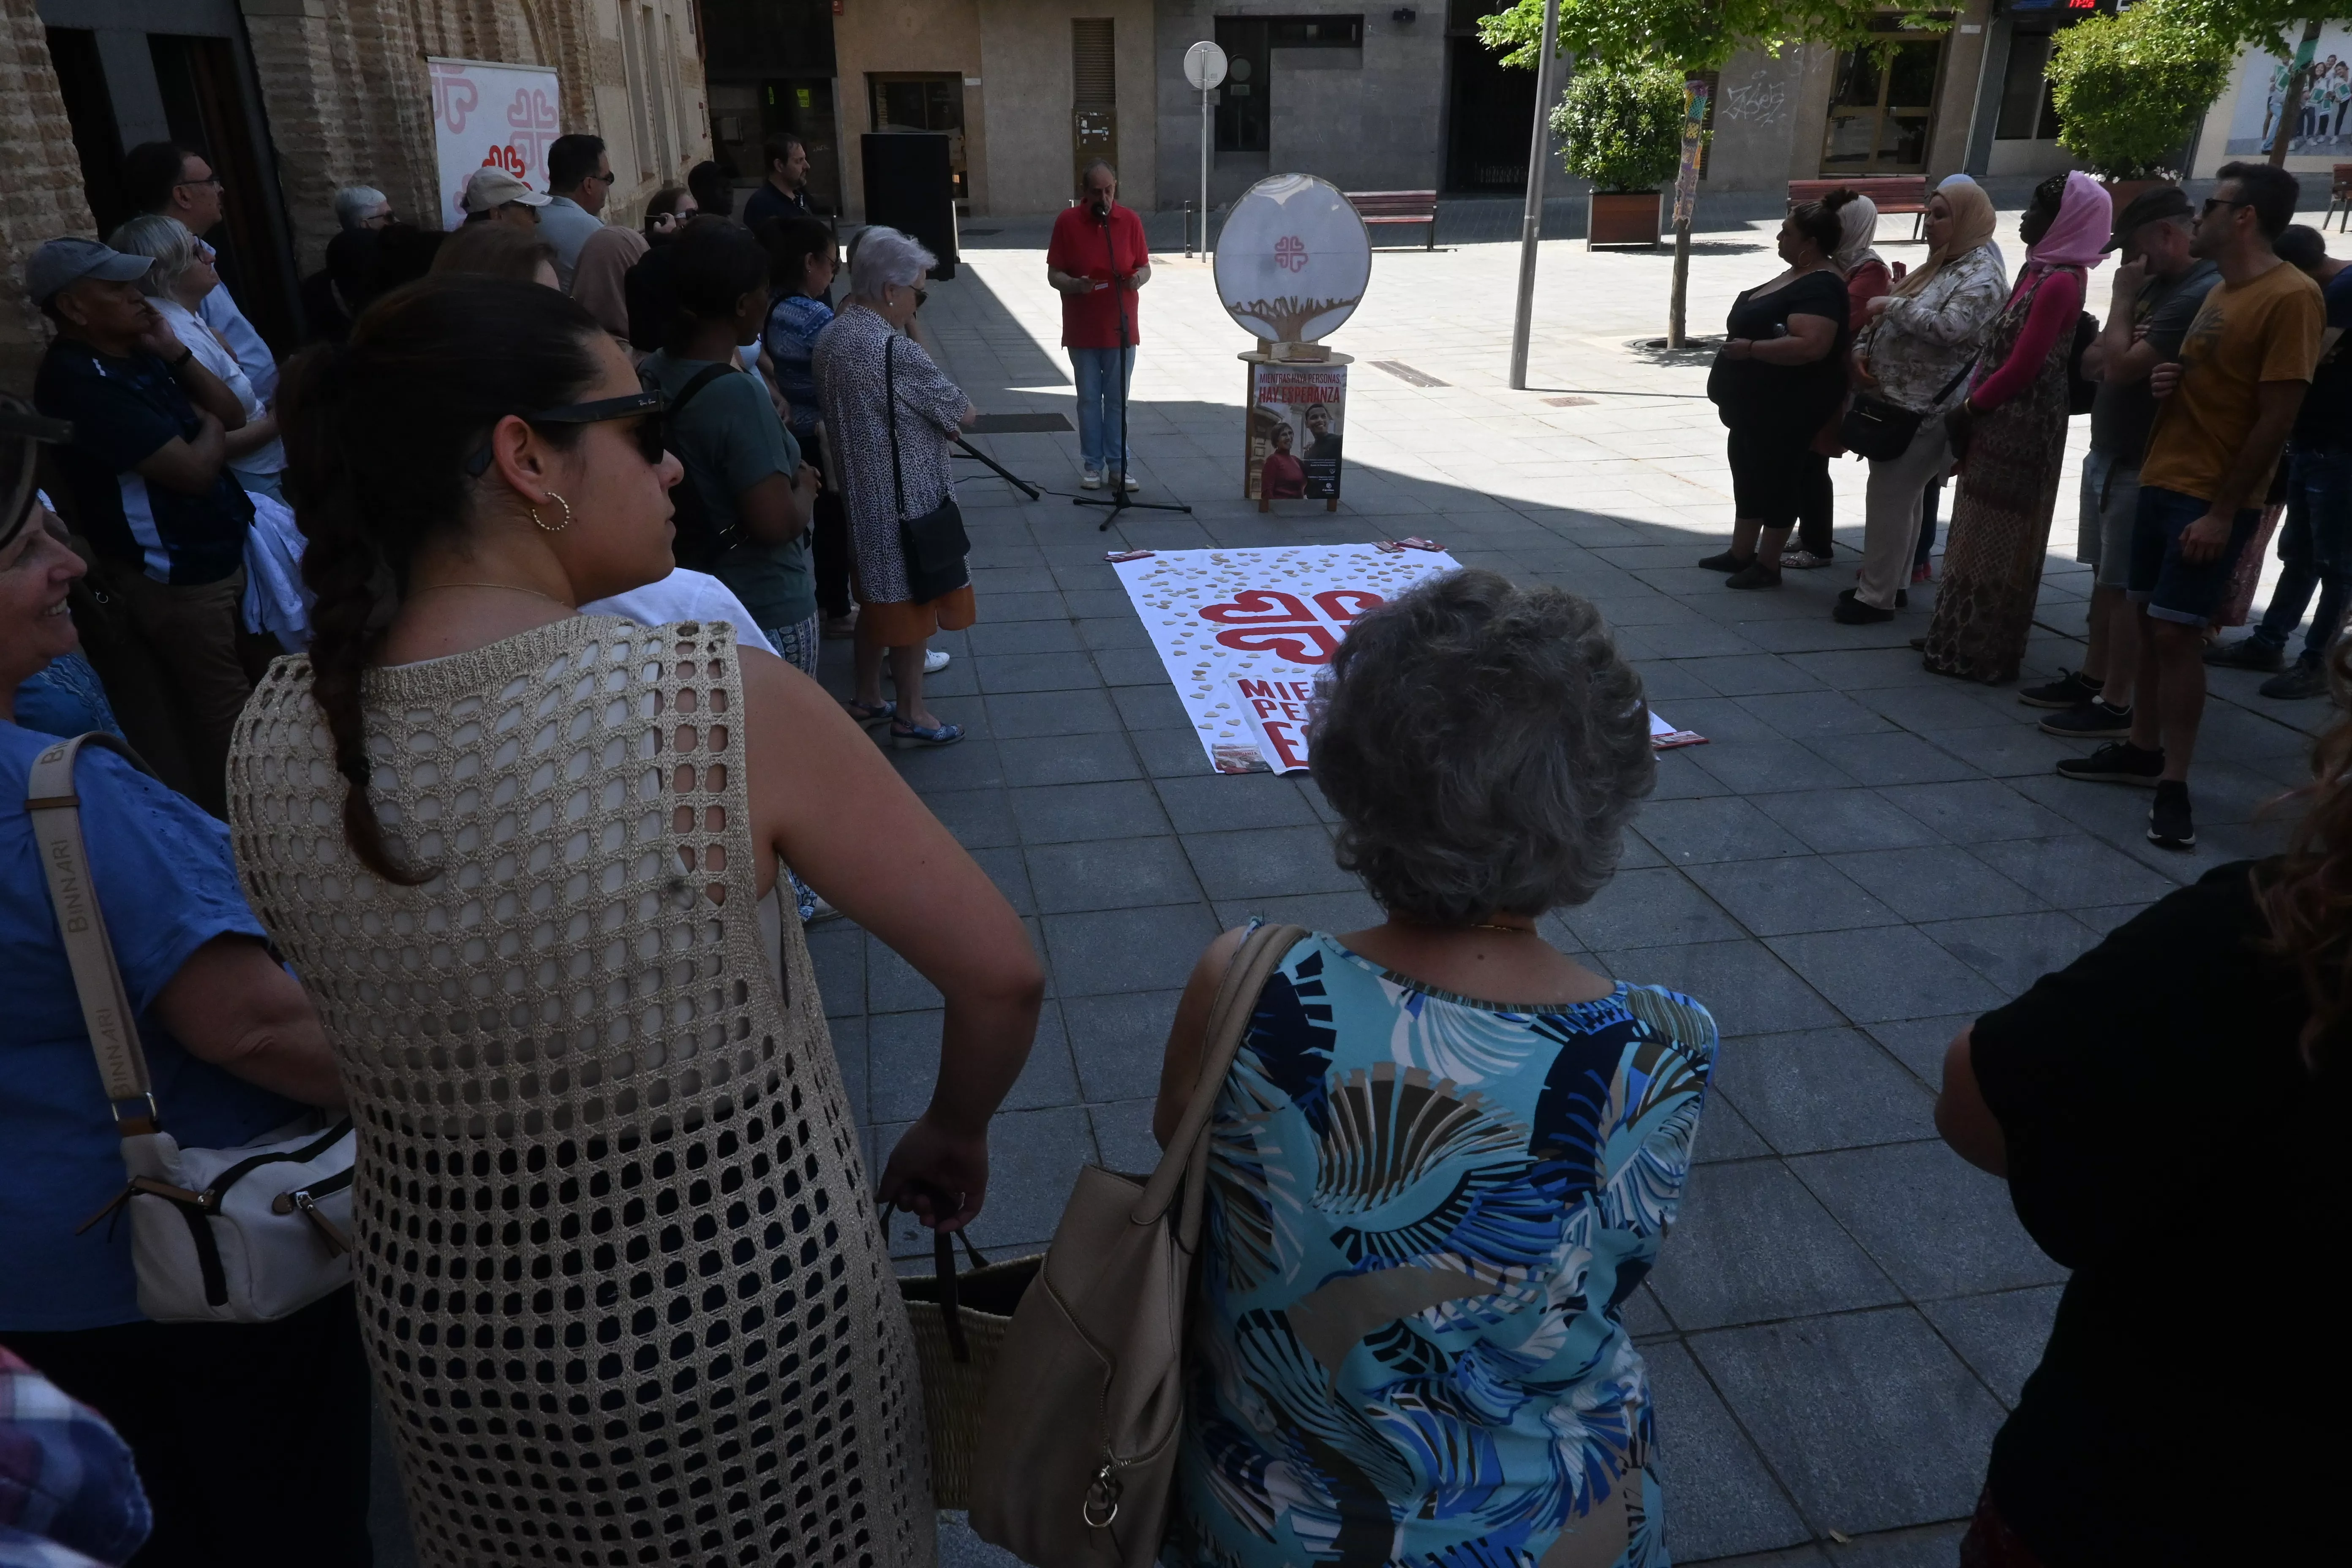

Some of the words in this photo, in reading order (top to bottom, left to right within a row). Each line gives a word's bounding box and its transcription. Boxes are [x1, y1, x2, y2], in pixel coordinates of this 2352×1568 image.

[1259, 387, 1279, 403] HAY
[1282, 386, 1340, 403] ESPERANZA
[1260, 373, 1290, 384] MIENTRAS
[1292, 373, 1307, 384] HAYA
[1308, 373, 1341, 384] PERSONAS,
[1262, 721, 1309, 768] E
[51, 839, 89, 933] BINNARI
[96, 1008, 133, 1097] BINNARI
